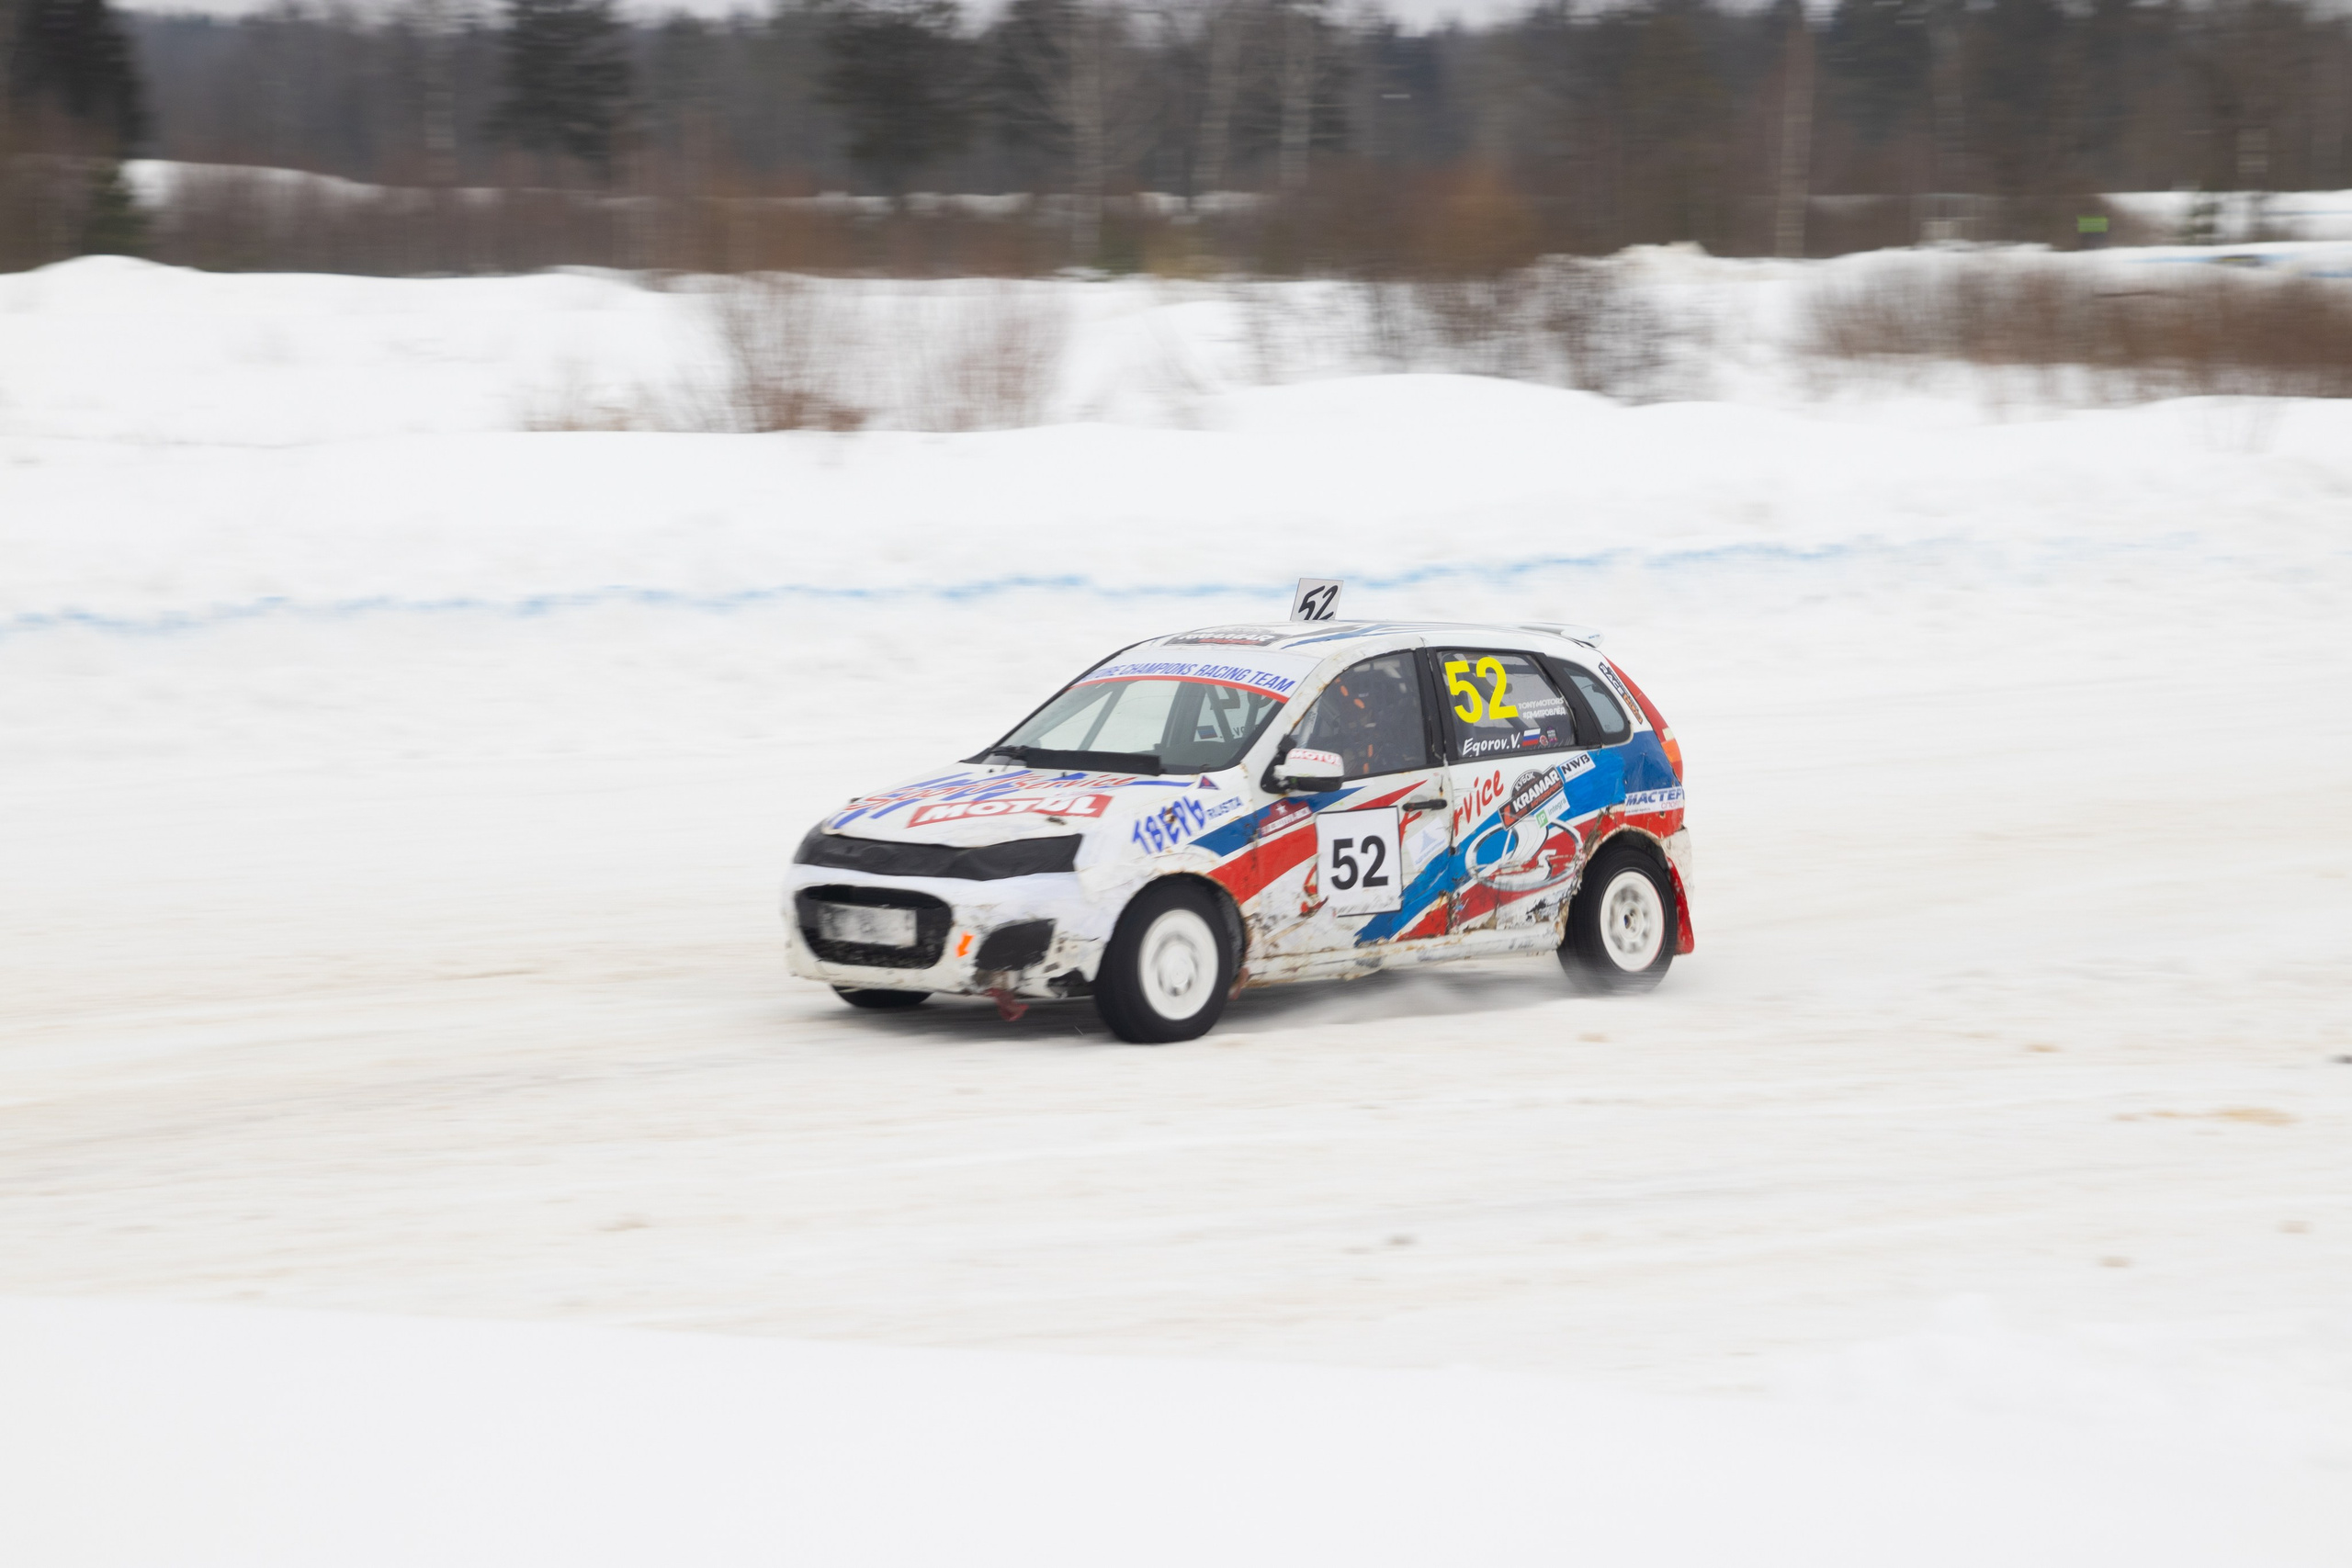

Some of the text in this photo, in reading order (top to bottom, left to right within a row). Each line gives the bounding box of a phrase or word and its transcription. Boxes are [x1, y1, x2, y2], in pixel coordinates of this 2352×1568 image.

[1298, 585, 1338, 620] 52
[1119, 662, 1198, 676] CHAMPIONS
[1193, 664, 1251, 682] RACING
[1248, 671, 1296, 692] TEAM
[1444, 656, 1519, 724] 52
[1518, 697, 1565, 710] TONYMOTORS
[1288, 750, 1341, 767] MOTUL
[1561, 754, 1590, 774] NWB
[1512, 770, 1560, 812] KRAMAR
[1514, 772, 1536, 791] КУБОК
[921, 795, 1100, 822] MOTUL
[1548, 797, 1566, 816] integra
[1330, 835, 1389, 891] 52
